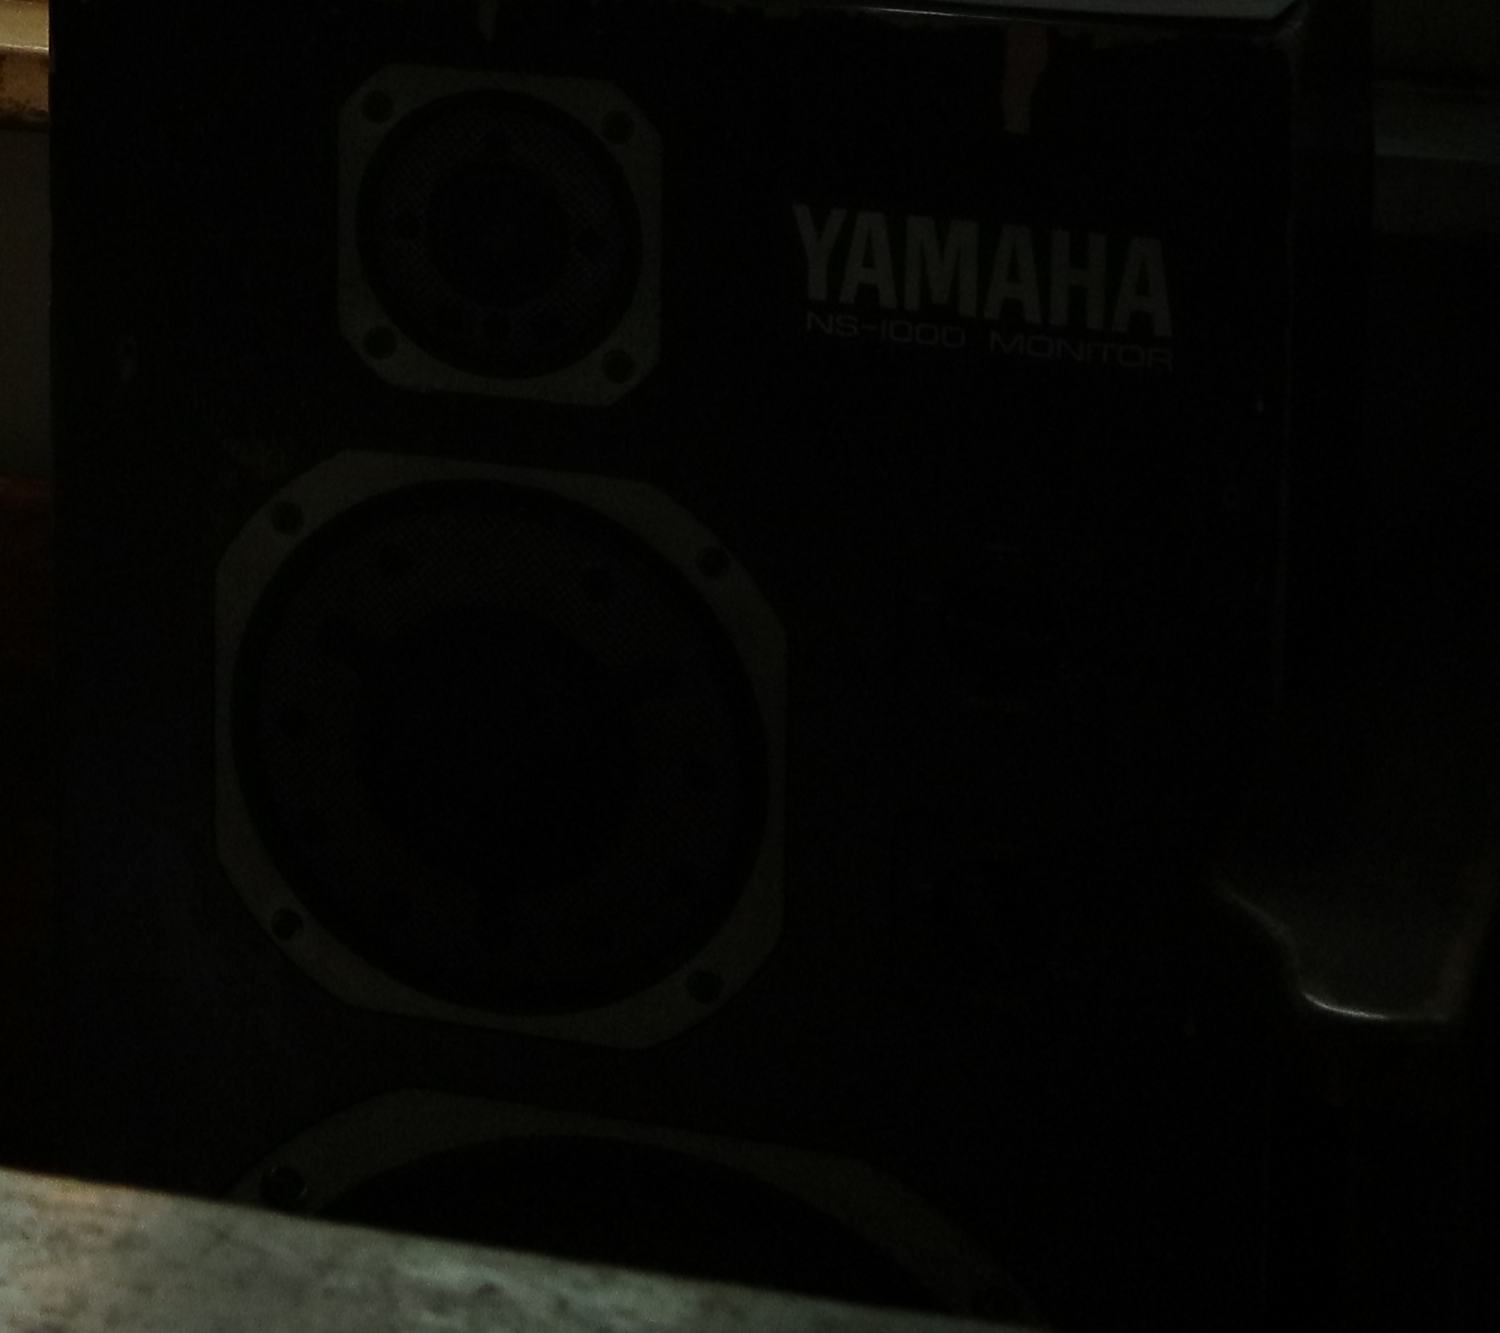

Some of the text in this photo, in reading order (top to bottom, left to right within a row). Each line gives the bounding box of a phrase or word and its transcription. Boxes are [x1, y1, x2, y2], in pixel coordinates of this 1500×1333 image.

[792, 203, 1172, 337] YAMAHA
[805, 310, 1175, 371] NS-1000 MONITOR
